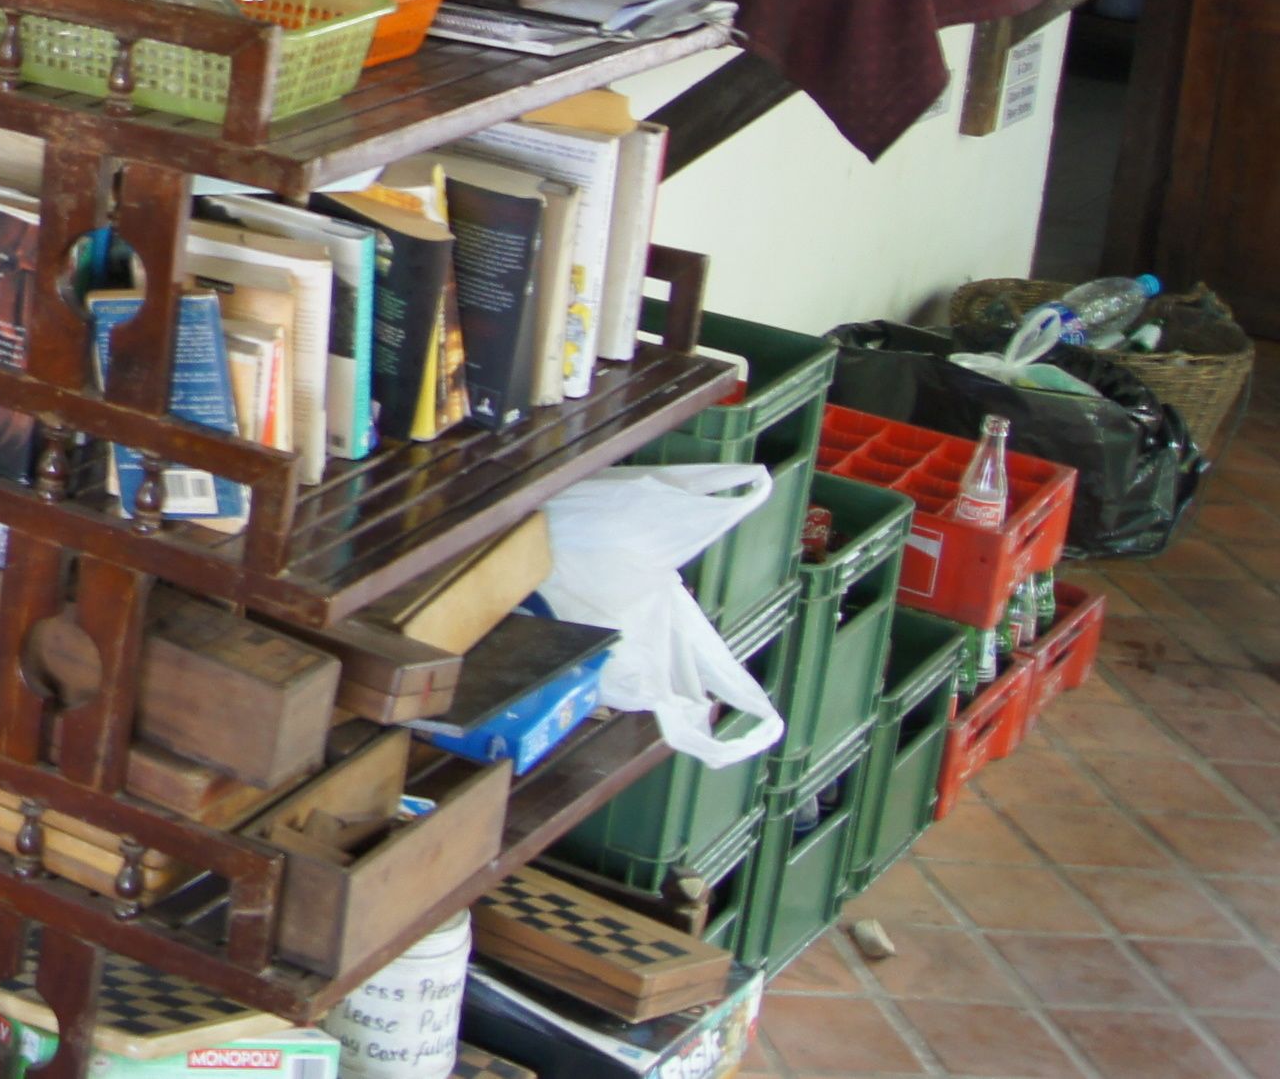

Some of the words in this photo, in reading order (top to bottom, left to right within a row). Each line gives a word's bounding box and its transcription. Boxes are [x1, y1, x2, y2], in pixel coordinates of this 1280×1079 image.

[364, 983, 406, 1001] ess
[340, 1034, 360, 1053] ay
[191, 1051, 280, 1067] MONOPOLY
